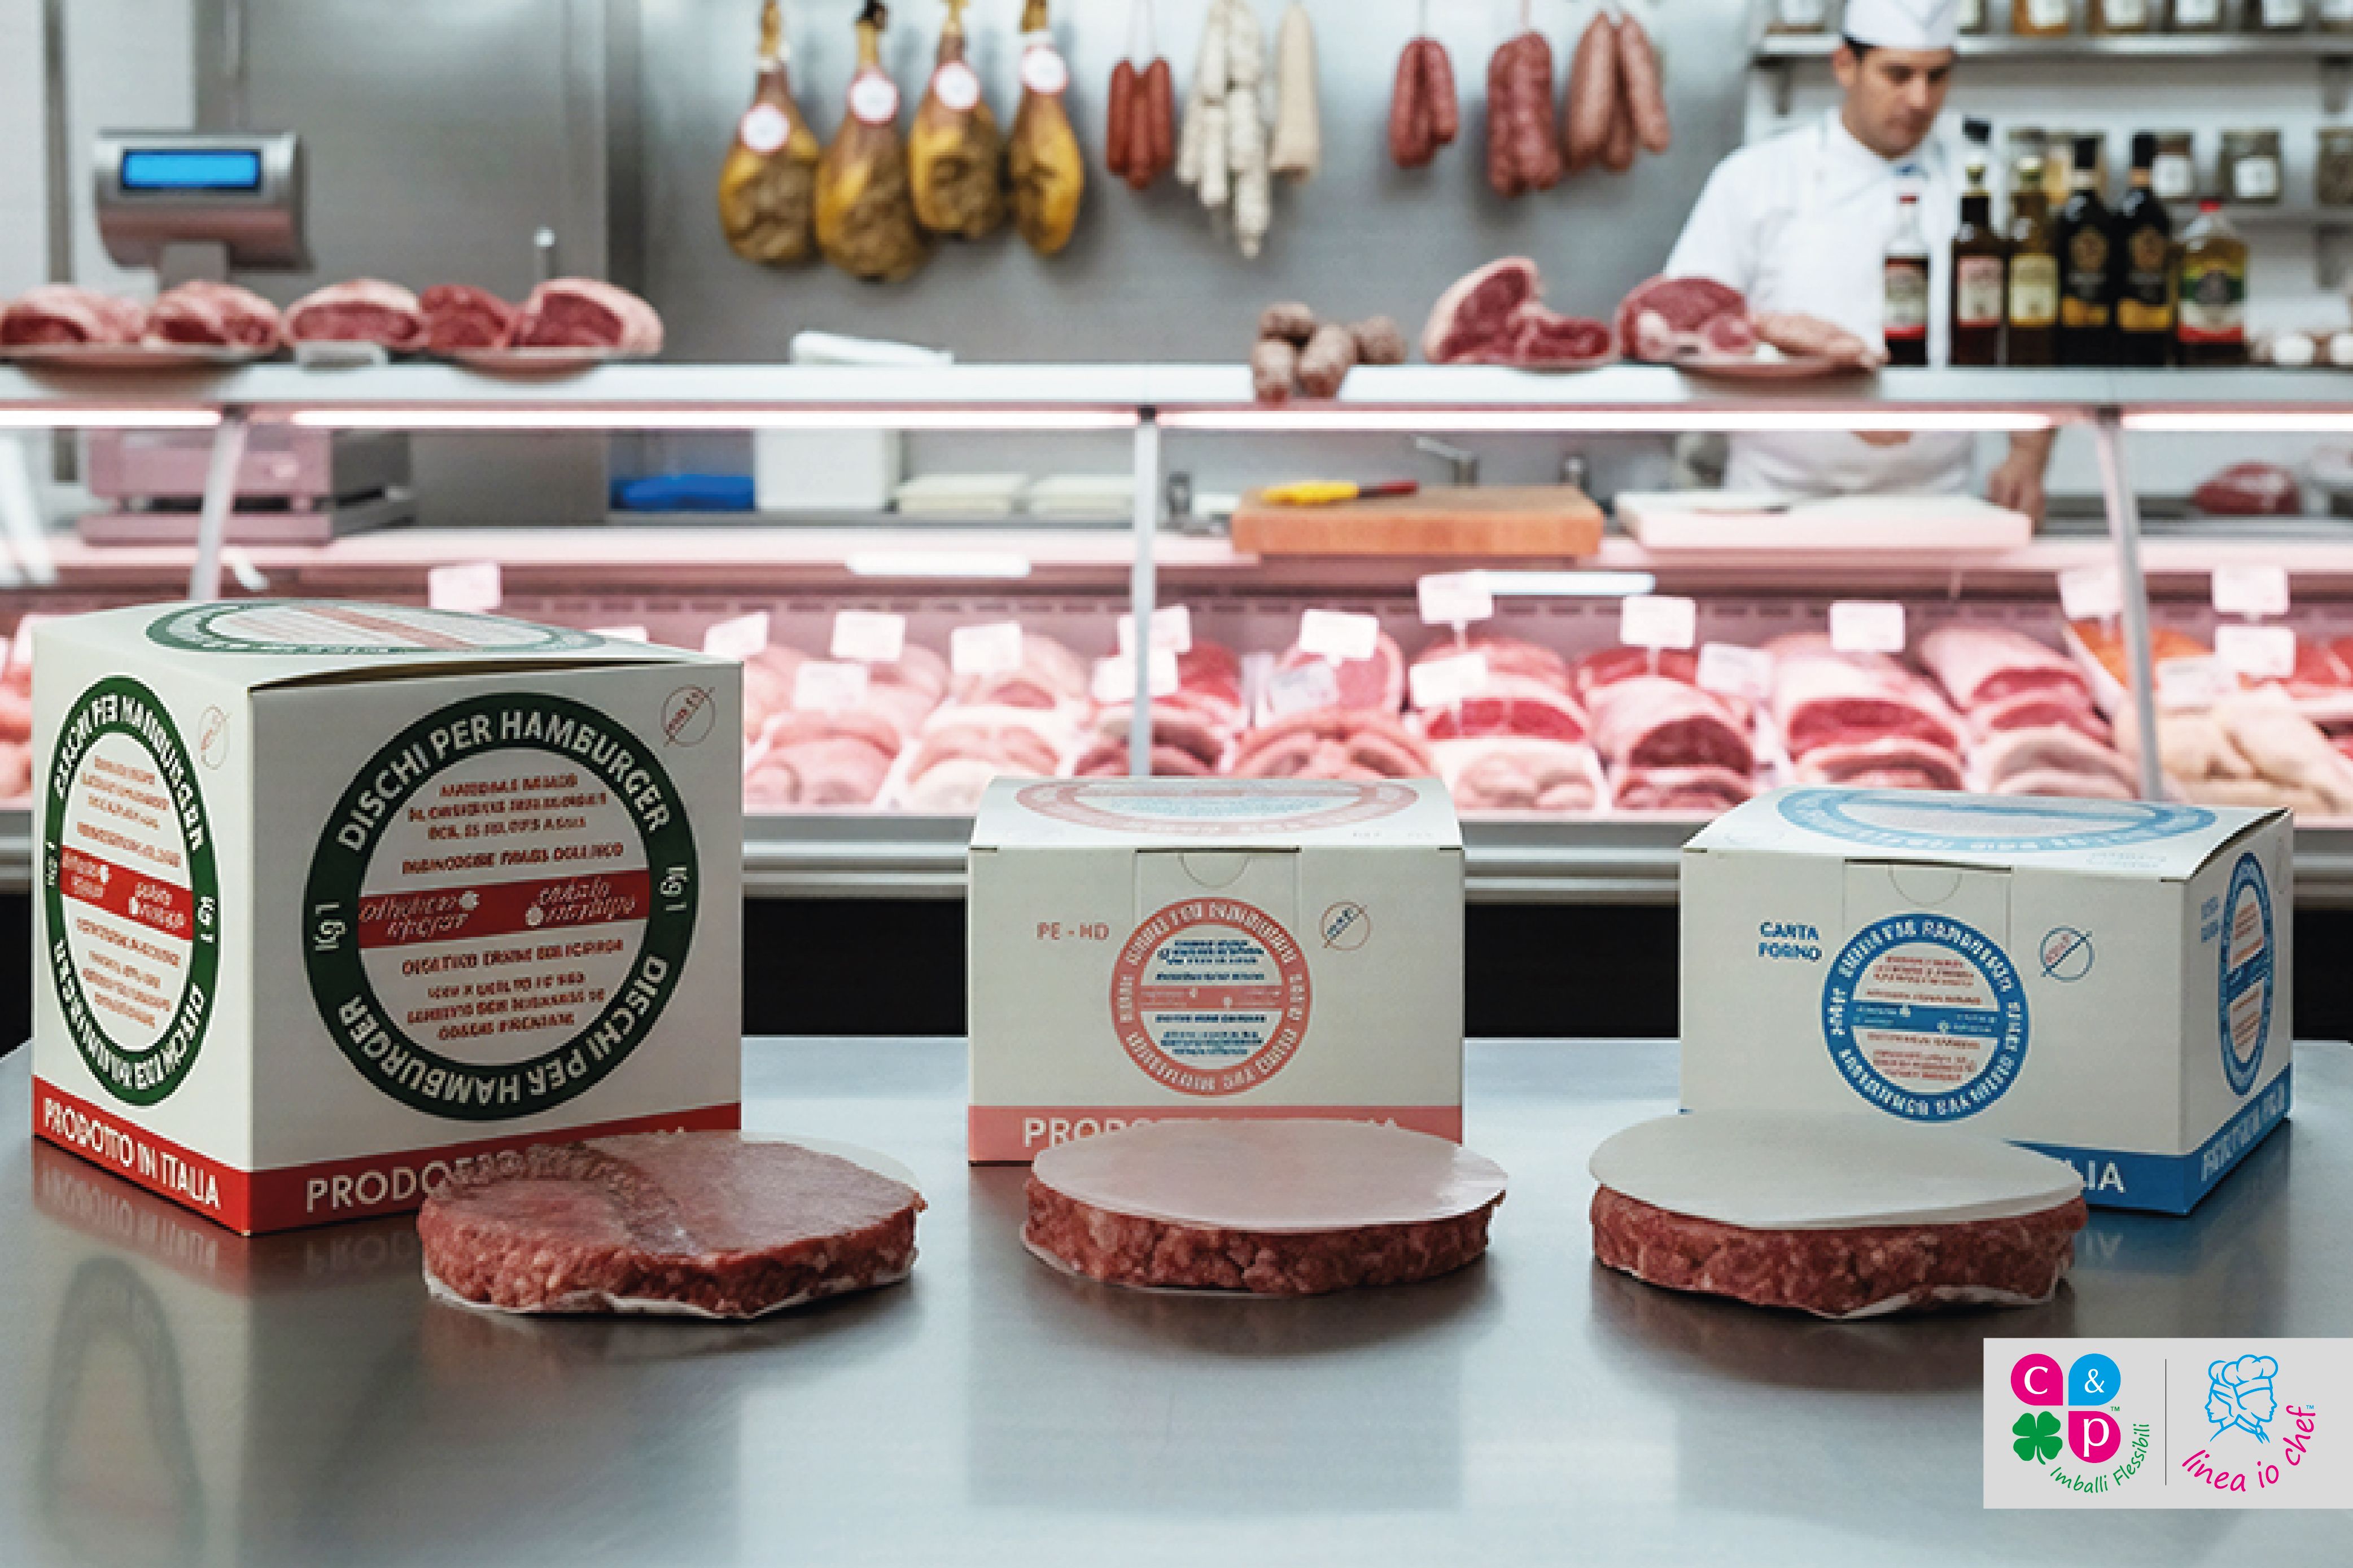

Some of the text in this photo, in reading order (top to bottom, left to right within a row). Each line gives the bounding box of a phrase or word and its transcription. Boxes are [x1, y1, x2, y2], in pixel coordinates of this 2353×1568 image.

[336, 743, 430, 850] DISCHI
[427, 714, 494, 759] PER
[501, 709, 670, 831] HAMBURGER
[1038, 922, 1060, 940] PE
[1758, 942, 1821, 962] FORNO
[1759, 921, 1819, 940] CARTA
[338, 955, 668, 1105] DISCHI PER HAMBURGER
[45, 1097, 221, 1210] PRODOTTO IN ITALIA
